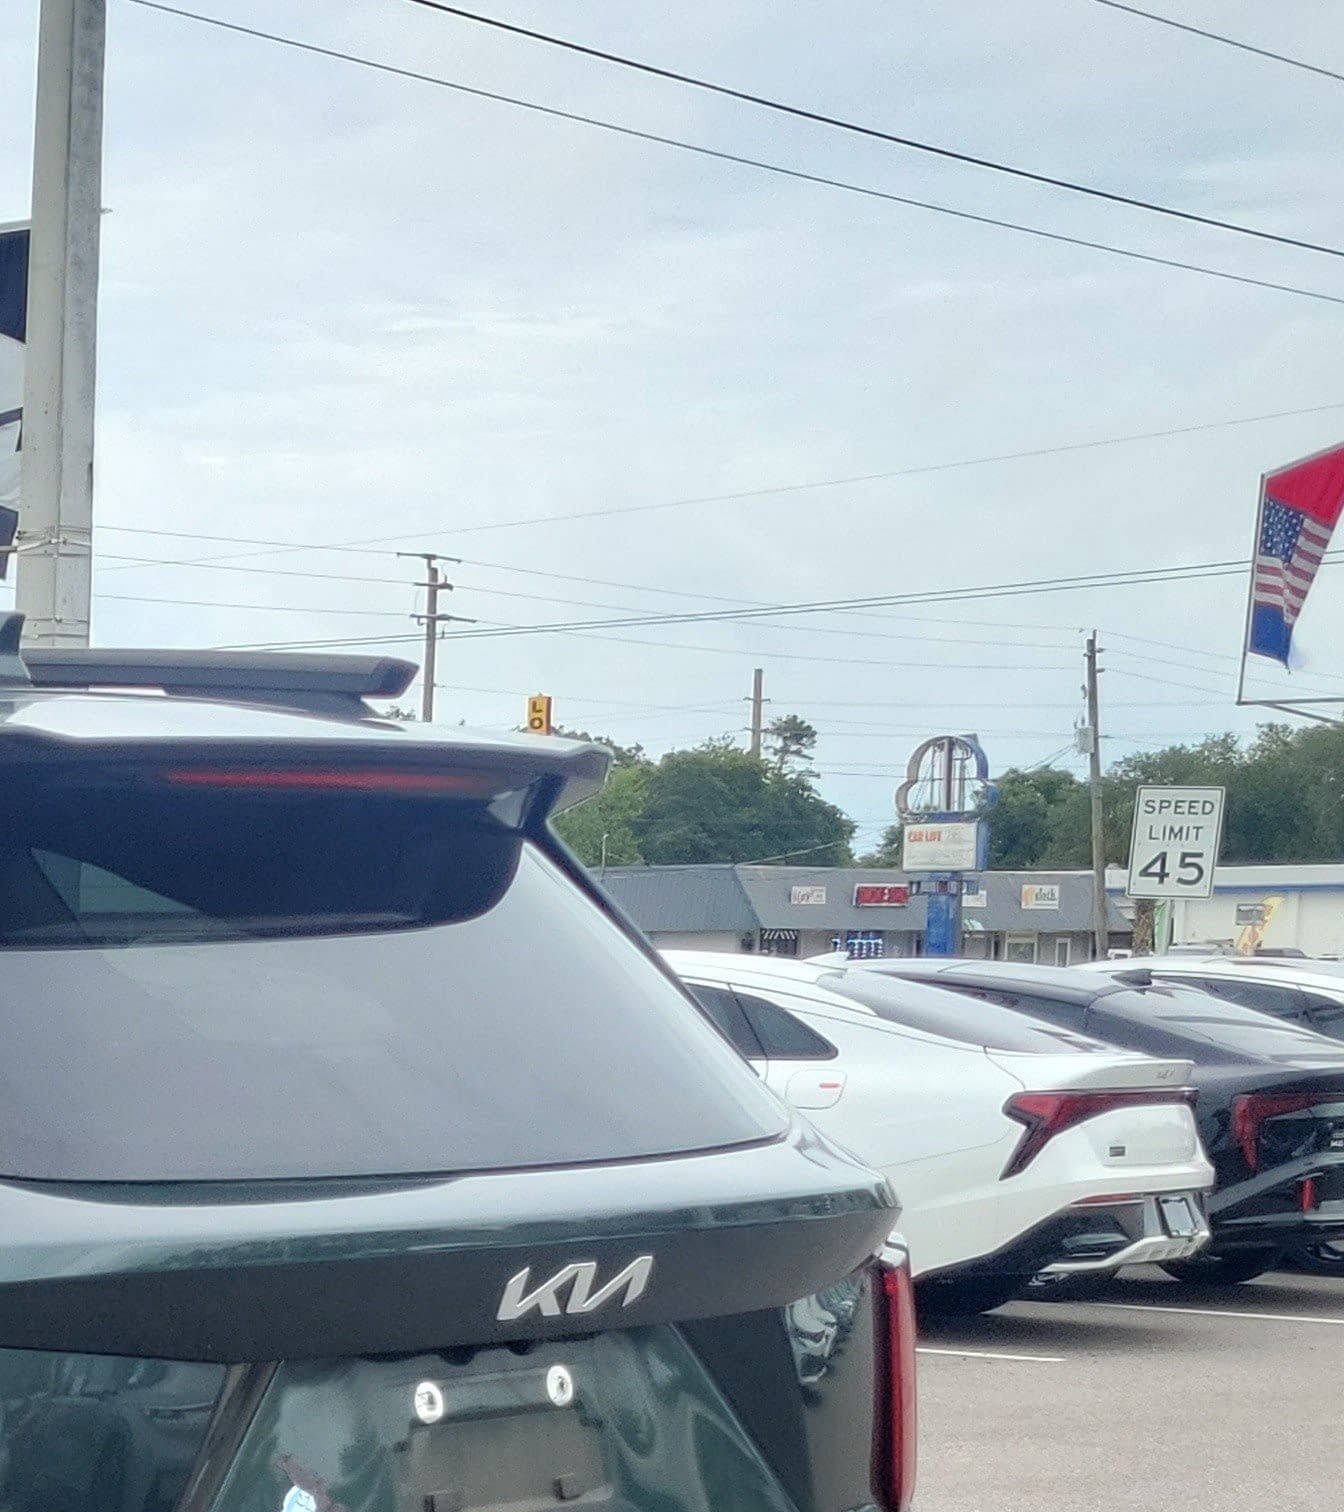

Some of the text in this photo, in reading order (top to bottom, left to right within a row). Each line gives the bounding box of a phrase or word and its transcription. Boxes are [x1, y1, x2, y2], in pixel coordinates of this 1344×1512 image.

[1143, 799, 1215, 816] SPEED
[1148, 824, 1204, 842] LIMIT
[1138, 851, 1205, 886] 45
[496, 1255, 654, 1321] KIA
